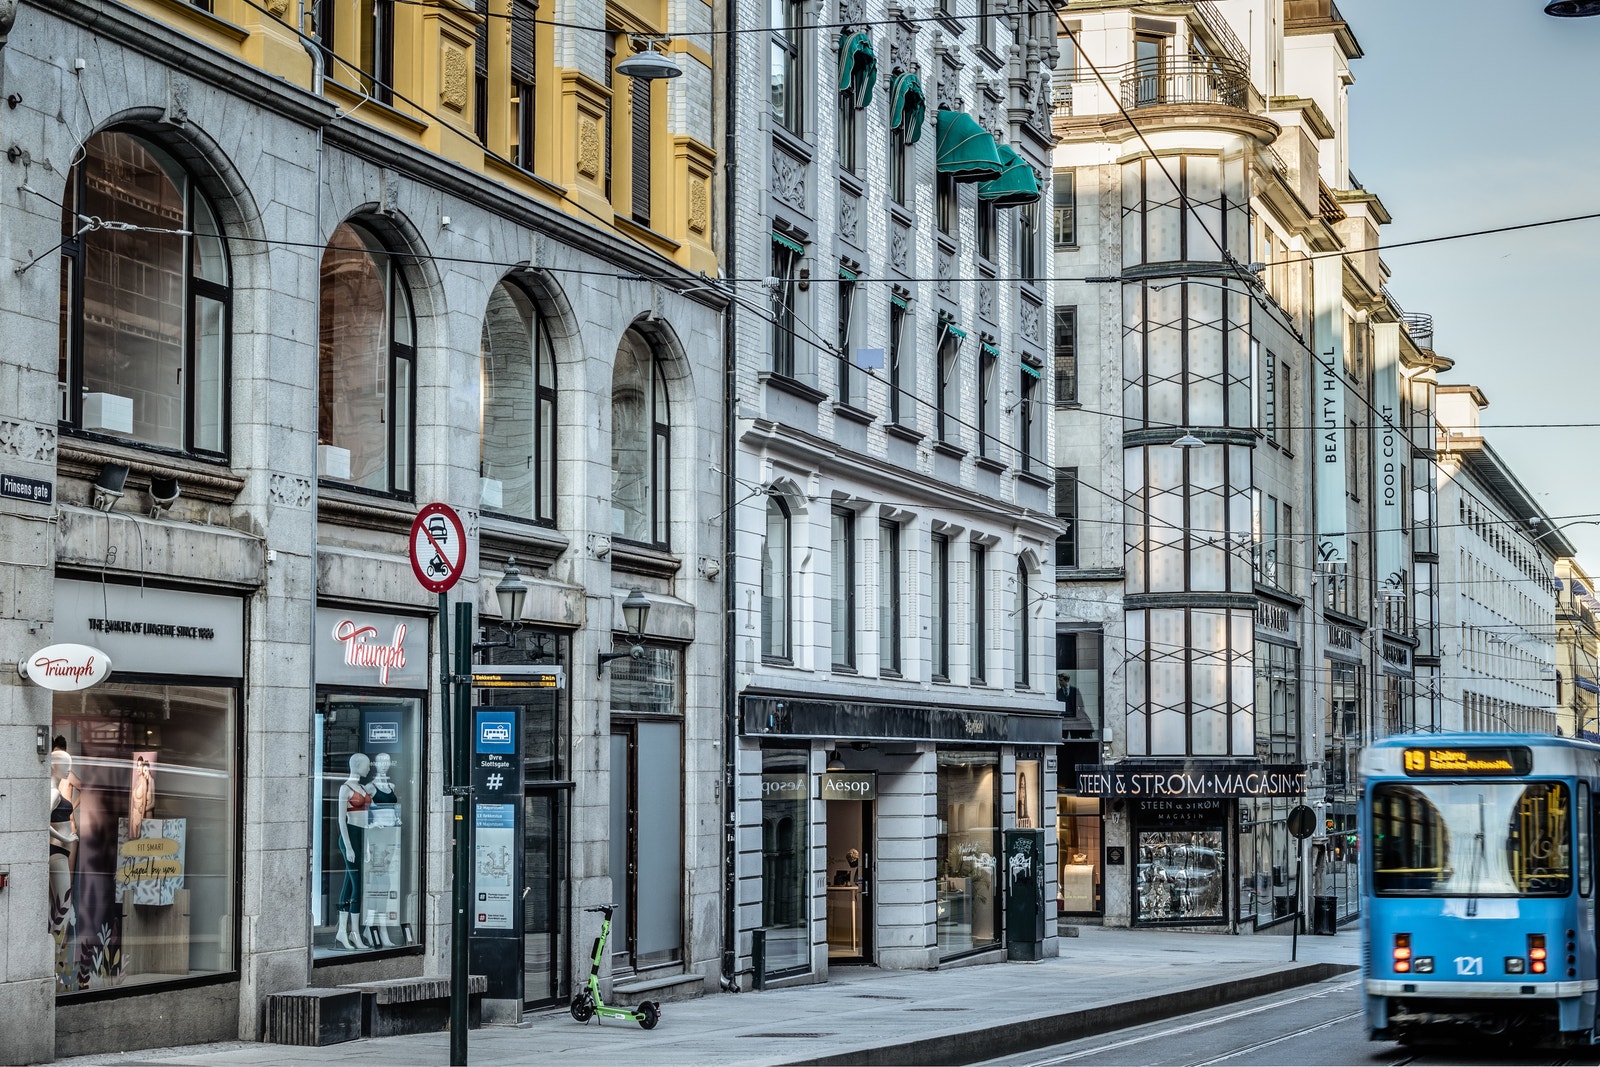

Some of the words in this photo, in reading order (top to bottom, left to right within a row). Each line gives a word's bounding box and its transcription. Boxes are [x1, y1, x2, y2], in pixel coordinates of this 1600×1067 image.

[1323, 347, 1336, 390] HALL
[1324, 397, 1337, 463] BEAUTY
[1383, 405, 1394, 458] COURT
[4, 478, 32, 495] Prinsens
[33, 484, 48, 500] gate
[1384, 462, 1395, 506] FOOD
[332, 620, 406, 685] Triumph
[35, 655, 95, 684] Triumph
[480, 760, 510, 769] Slottsgate
[1404, 750, 1425, 771] 19
[1079, 774, 1111, 794] STEEN
[1115, 774, 1127, 794] &
[1131, 773, 1205, 795] STRØM
[1214, 773, 1292, 794] MAGASIN
[1140, 801, 1173, 810] STEEN
[147, 843, 164, 851] SMART
[123, 856, 150, 887] Shaped
[150, 856, 161, 887] by
[1453, 956, 1483, 975] 121
